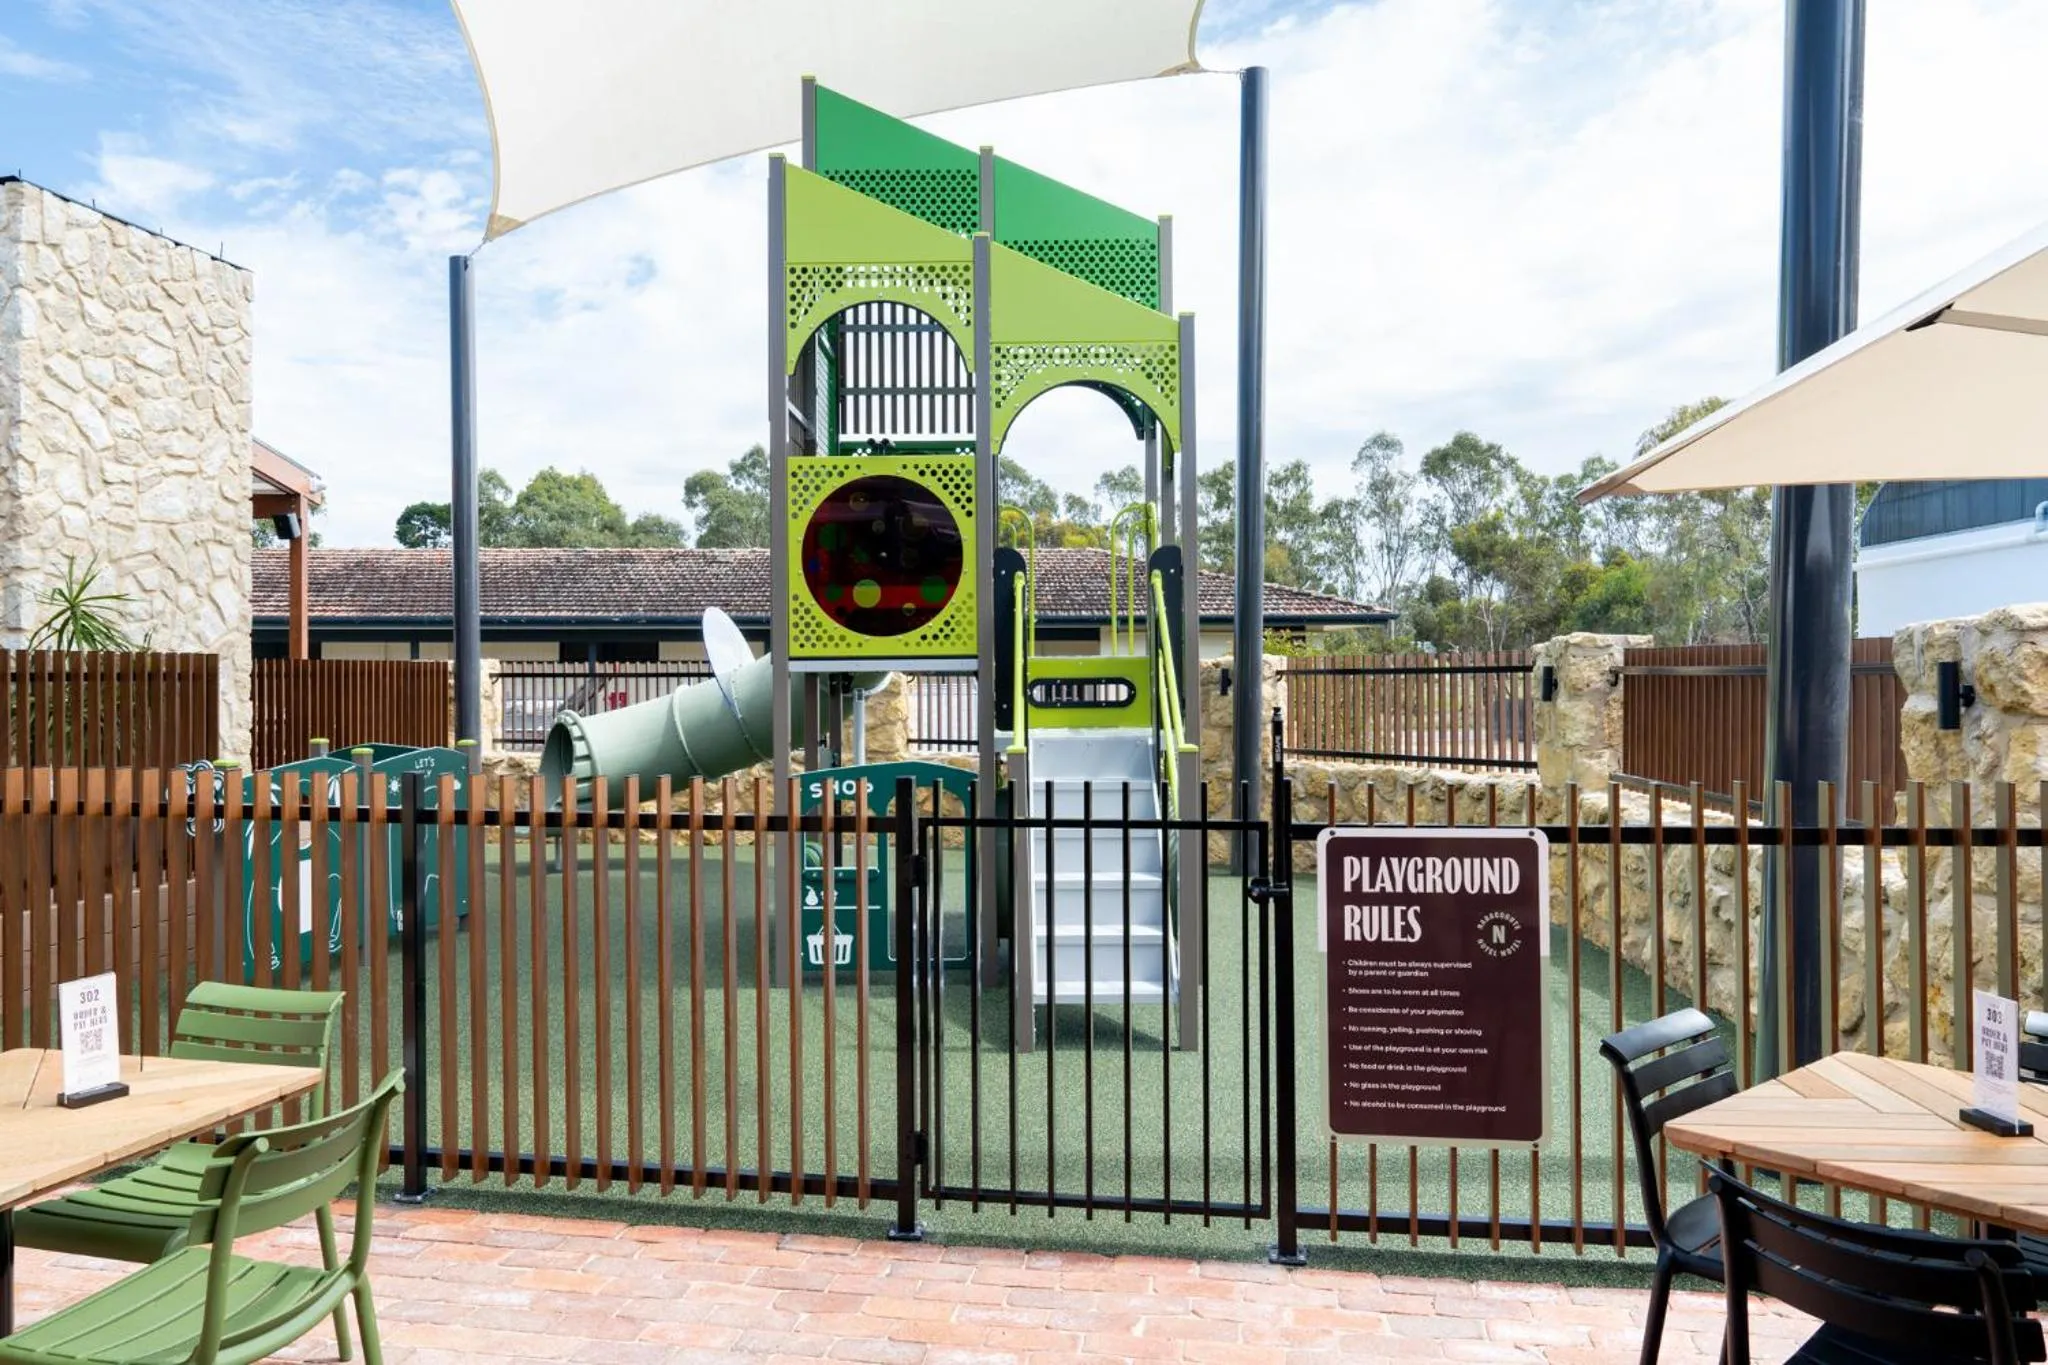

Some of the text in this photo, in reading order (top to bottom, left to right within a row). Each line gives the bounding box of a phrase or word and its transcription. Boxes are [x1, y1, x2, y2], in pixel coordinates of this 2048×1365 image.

[1343, 855, 1520, 895] PLAYGROUND
[1344, 904, 1422, 943] RULES
[1492, 924, 1506, 944] N
[80, 988, 100, 1004] 302
